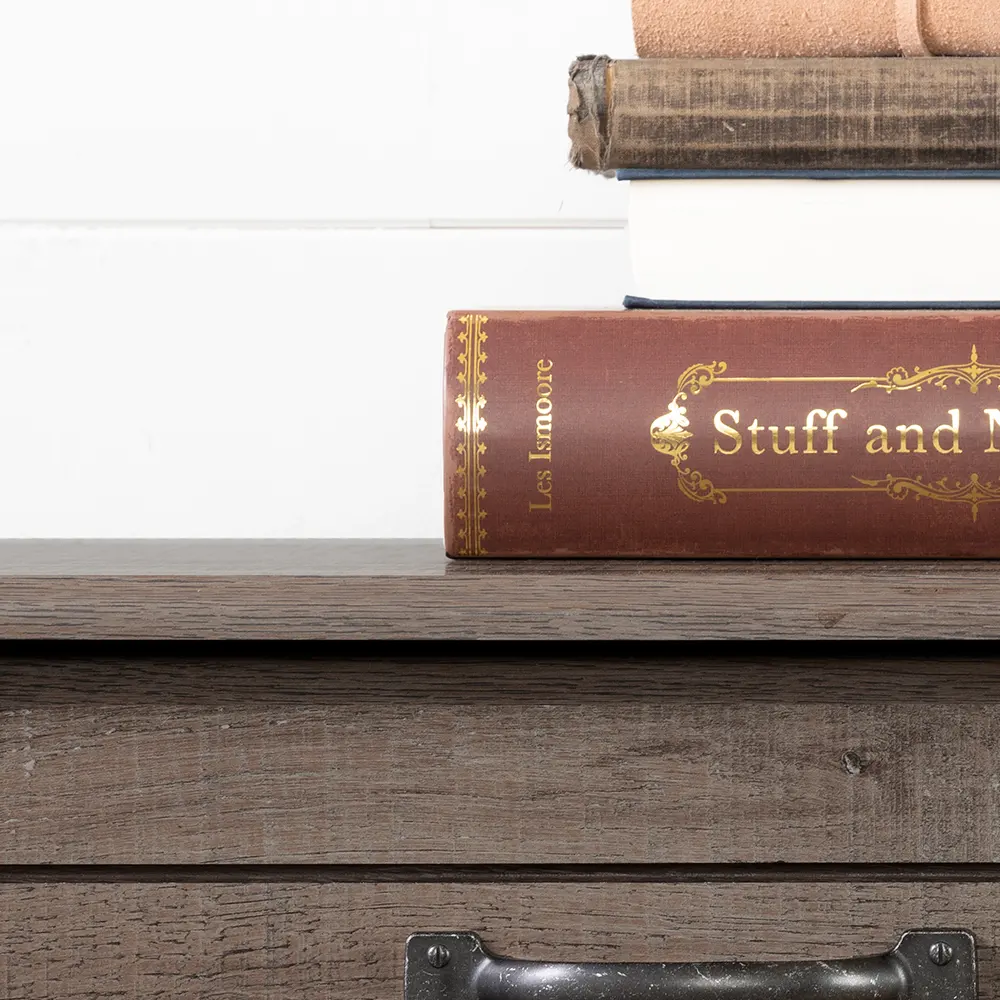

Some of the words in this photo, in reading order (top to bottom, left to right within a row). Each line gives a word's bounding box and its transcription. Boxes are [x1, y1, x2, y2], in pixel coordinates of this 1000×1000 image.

[529, 358, 554, 463] Ismoore
[713, 408, 848, 455] Stuff
[866, 407, 963, 455] and
[529, 470, 553, 512] Les
